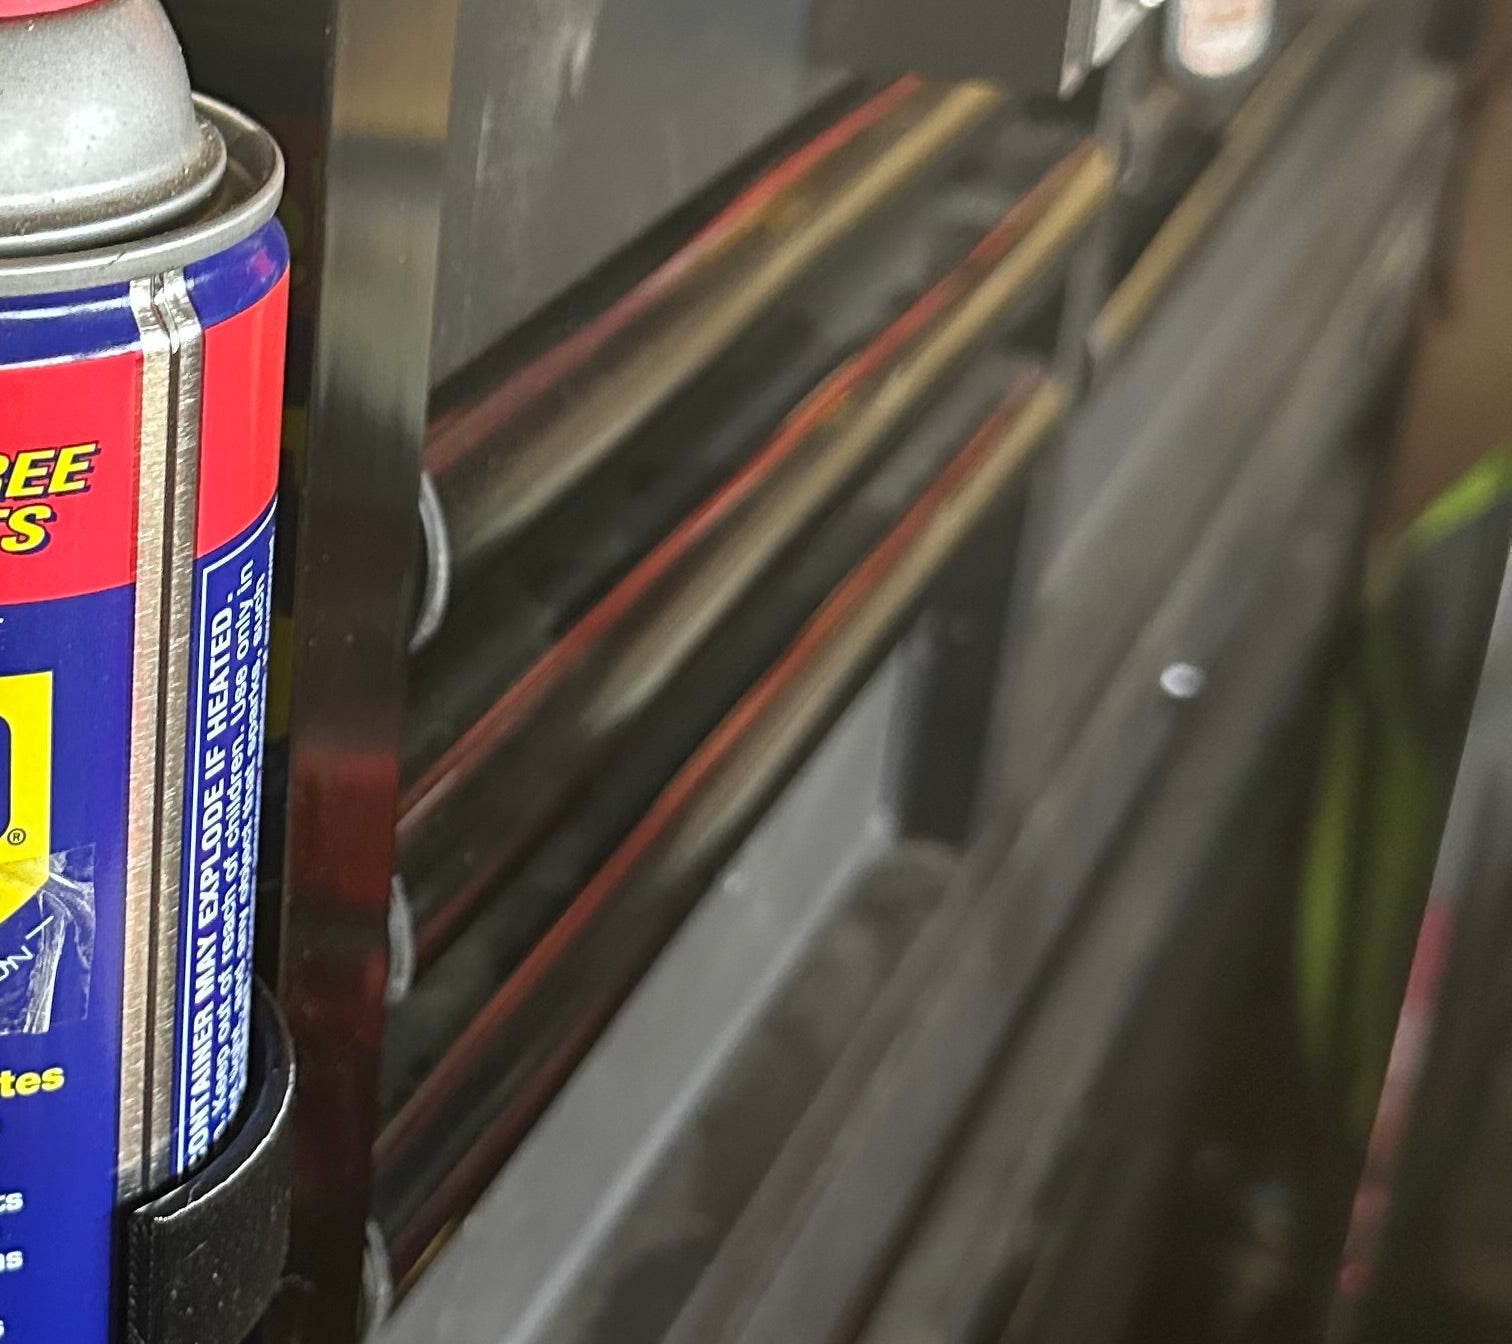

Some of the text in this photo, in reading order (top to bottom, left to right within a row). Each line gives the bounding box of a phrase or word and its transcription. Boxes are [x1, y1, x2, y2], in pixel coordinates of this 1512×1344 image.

[246, 646, 263, 757] sparks,
[252, 572, 266, 648] such
[188, 592, 234, 1166] CONTAINER MAY EXPLODE IF HEATED.
[210, 560, 254, 1118] Keep out of reach of children. Use only in
